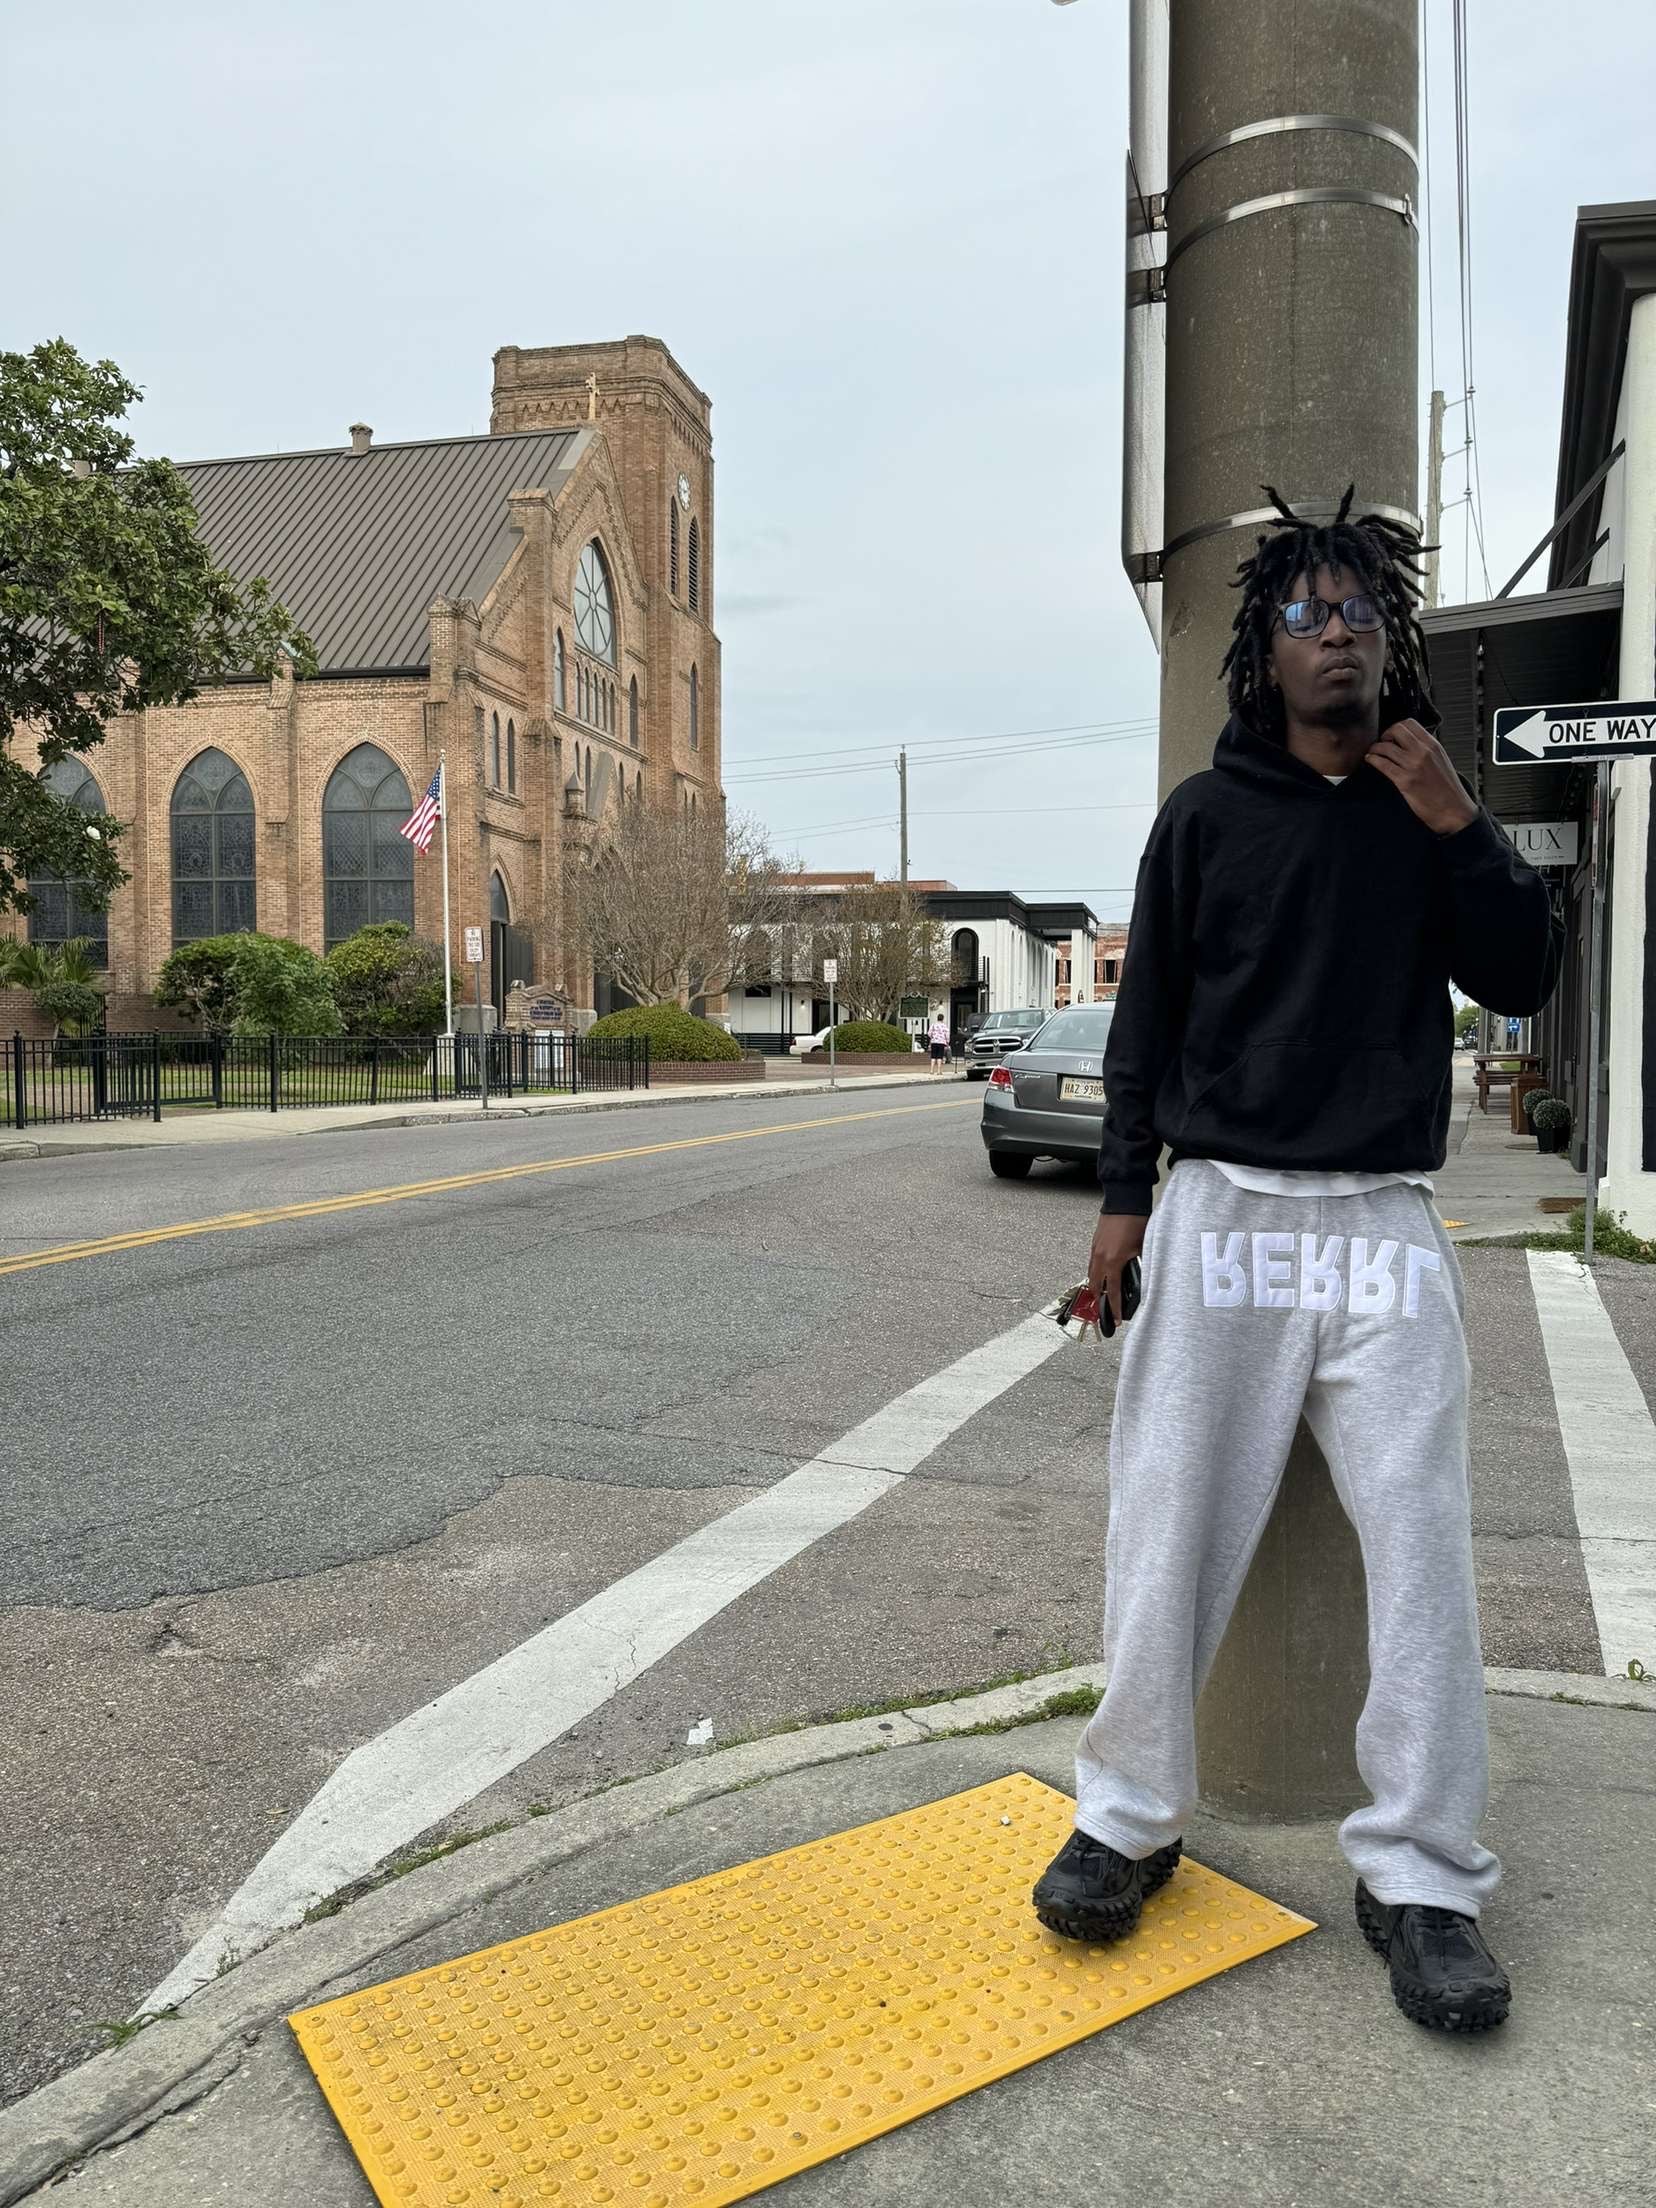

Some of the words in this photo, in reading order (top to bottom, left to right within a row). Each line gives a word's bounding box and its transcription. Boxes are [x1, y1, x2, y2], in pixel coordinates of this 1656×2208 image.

[1549, 721, 1596, 744] ONE
[1607, 718, 1656, 741] WAY
[1513, 828, 1563, 851] LUX
[1064, 1083, 1079, 1094] HAZ
[1083, 1084, 1103, 1096] 9305
